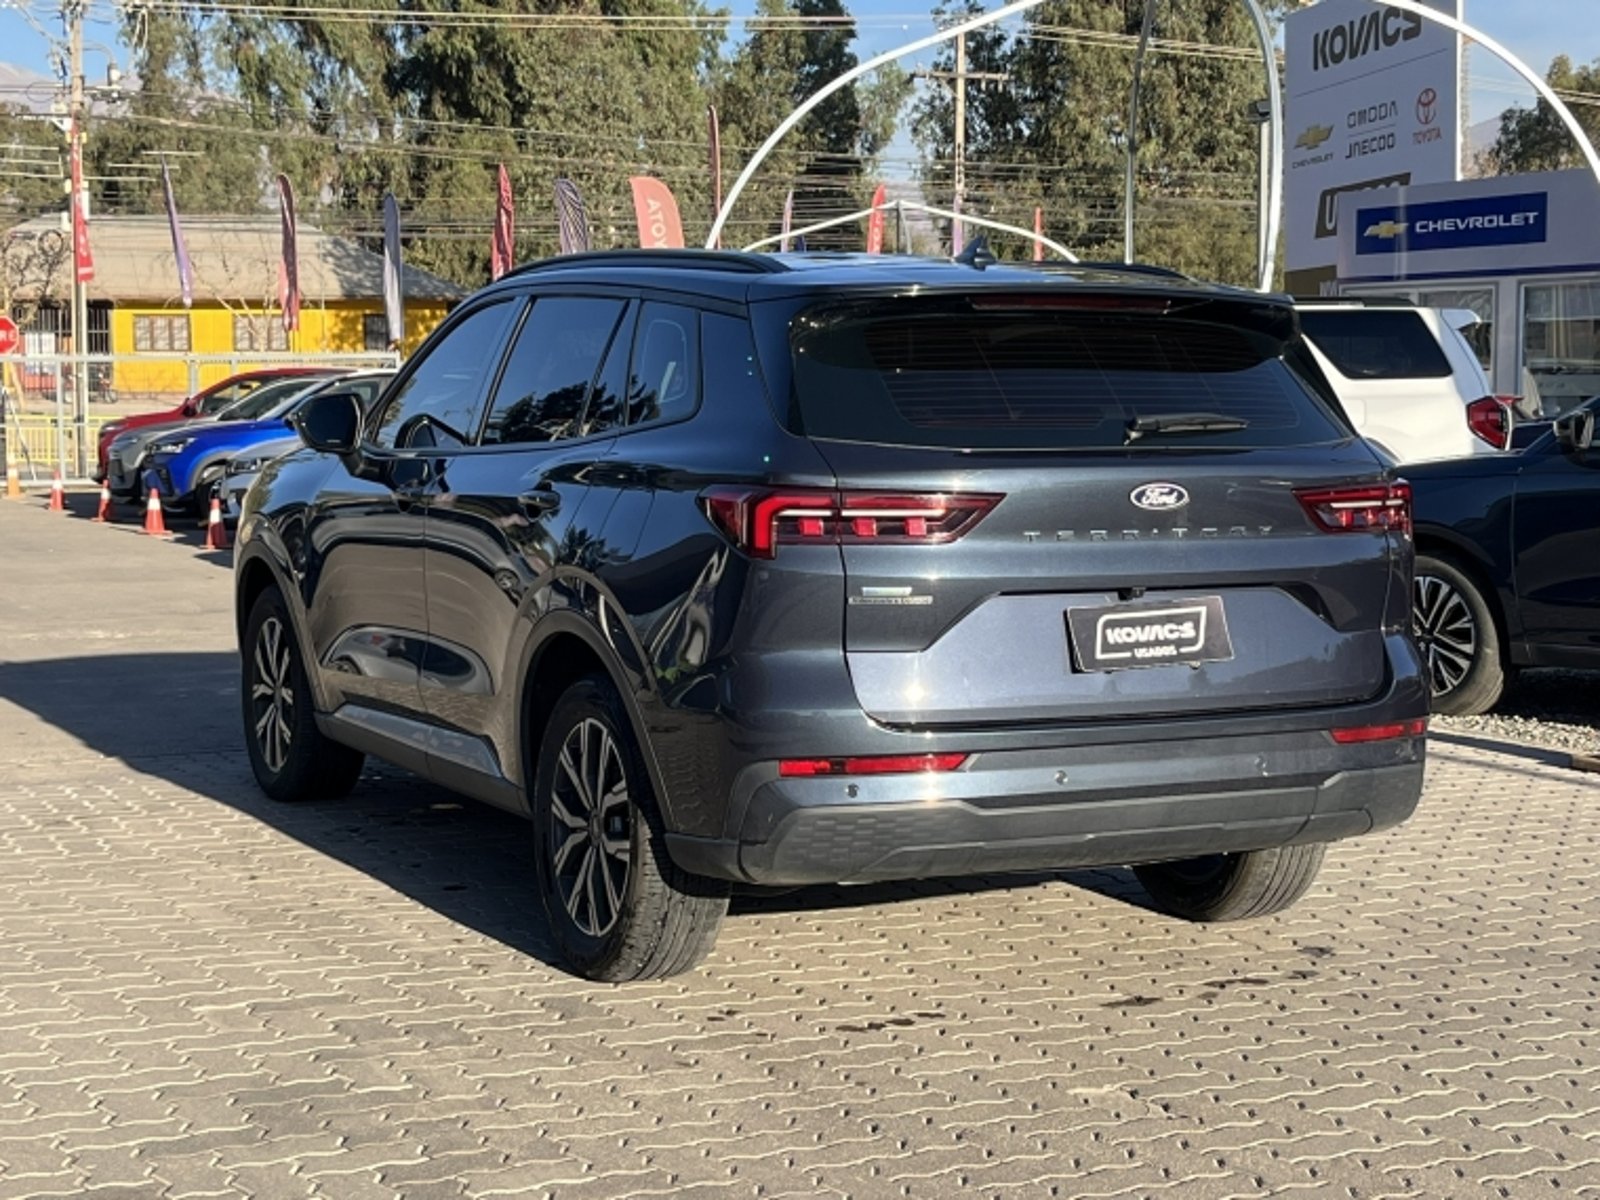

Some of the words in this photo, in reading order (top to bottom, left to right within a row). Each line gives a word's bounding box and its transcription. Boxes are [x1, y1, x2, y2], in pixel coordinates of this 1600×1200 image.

[1313, 7, 1421, 71] KOVACS
[1346, 100, 1399, 129] OMODA
[1413, 127, 1442, 145] TOYOTA
[1291, 152, 1335, 170] CHEVROLET
[1415, 211, 1539, 234] CHEVROLET
[1106, 621, 1196, 645] KOVACS
[1134, 644, 1178, 659] USADOS
